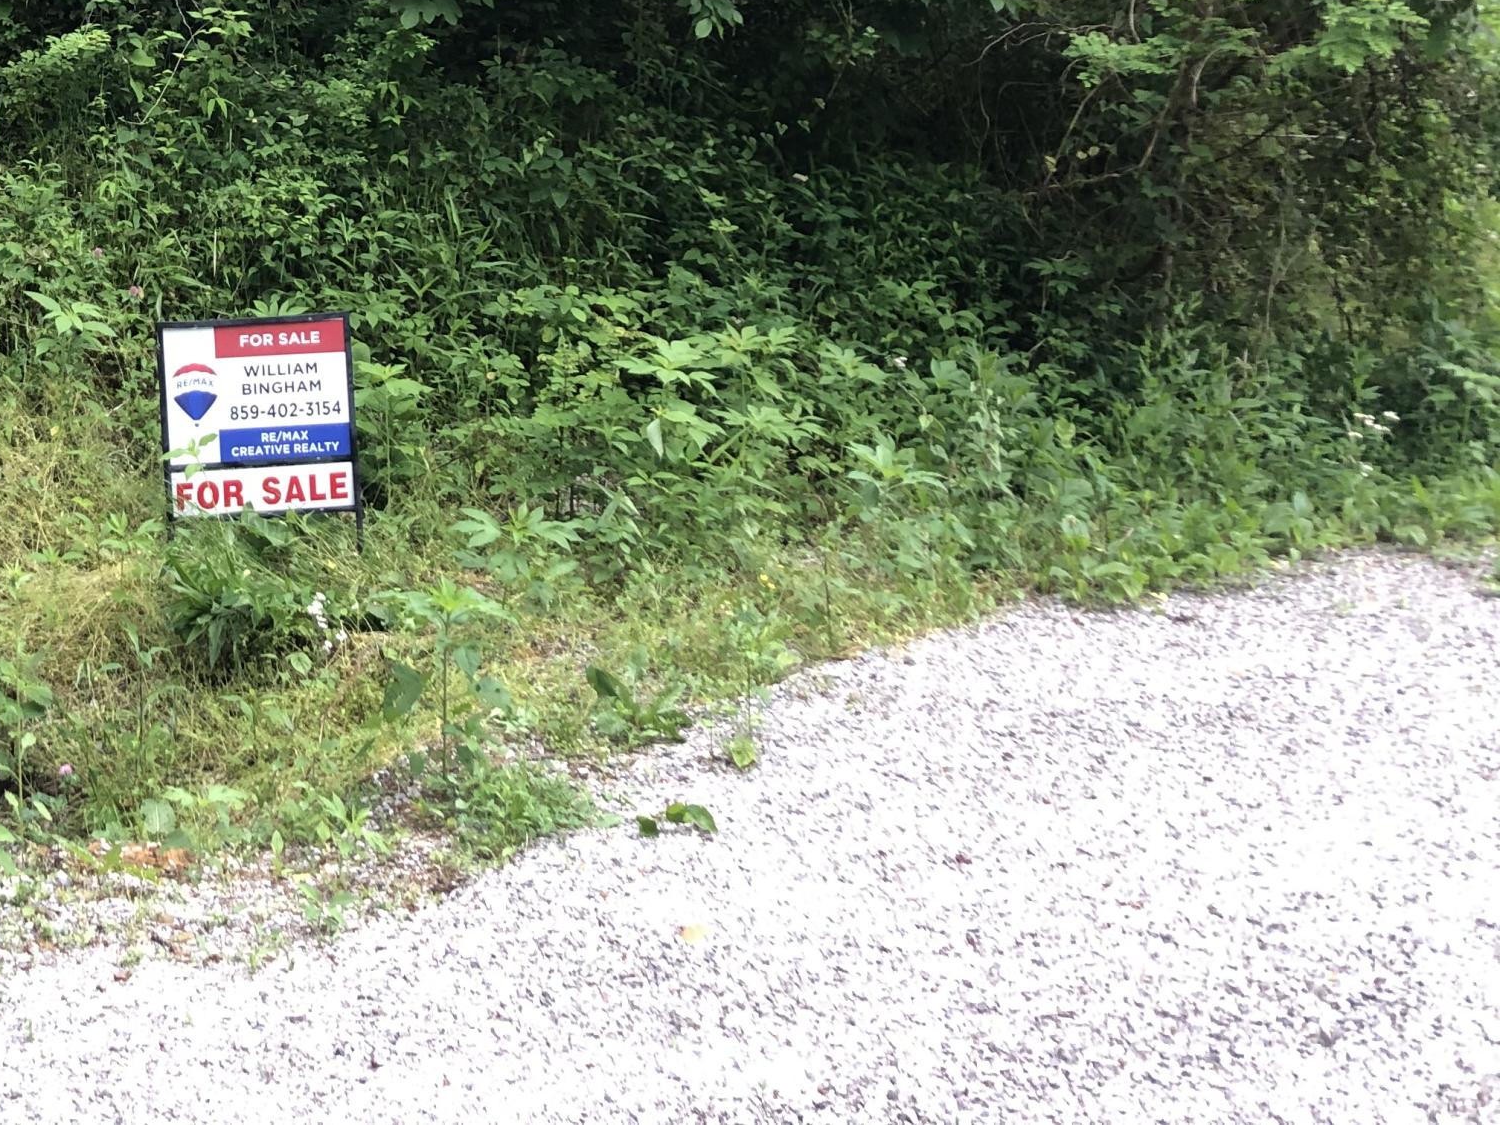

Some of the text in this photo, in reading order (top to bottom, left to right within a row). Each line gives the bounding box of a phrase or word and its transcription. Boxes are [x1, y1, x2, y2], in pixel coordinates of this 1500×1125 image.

[239, 331, 320, 347] FOR SALE
[244, 362, 318, 377] WILLIAM
[176, 378, 214, 389] RE/MAX
[242, 380, 322, 395] BINGHAM
[230, 400, 341, 420] 859-402-3154
[261, 430, 309, 442] RE/MAX
[231, 441, 340, 457] CREATIVE REALTY
[176, 472, 349, 512] FOR SALE
